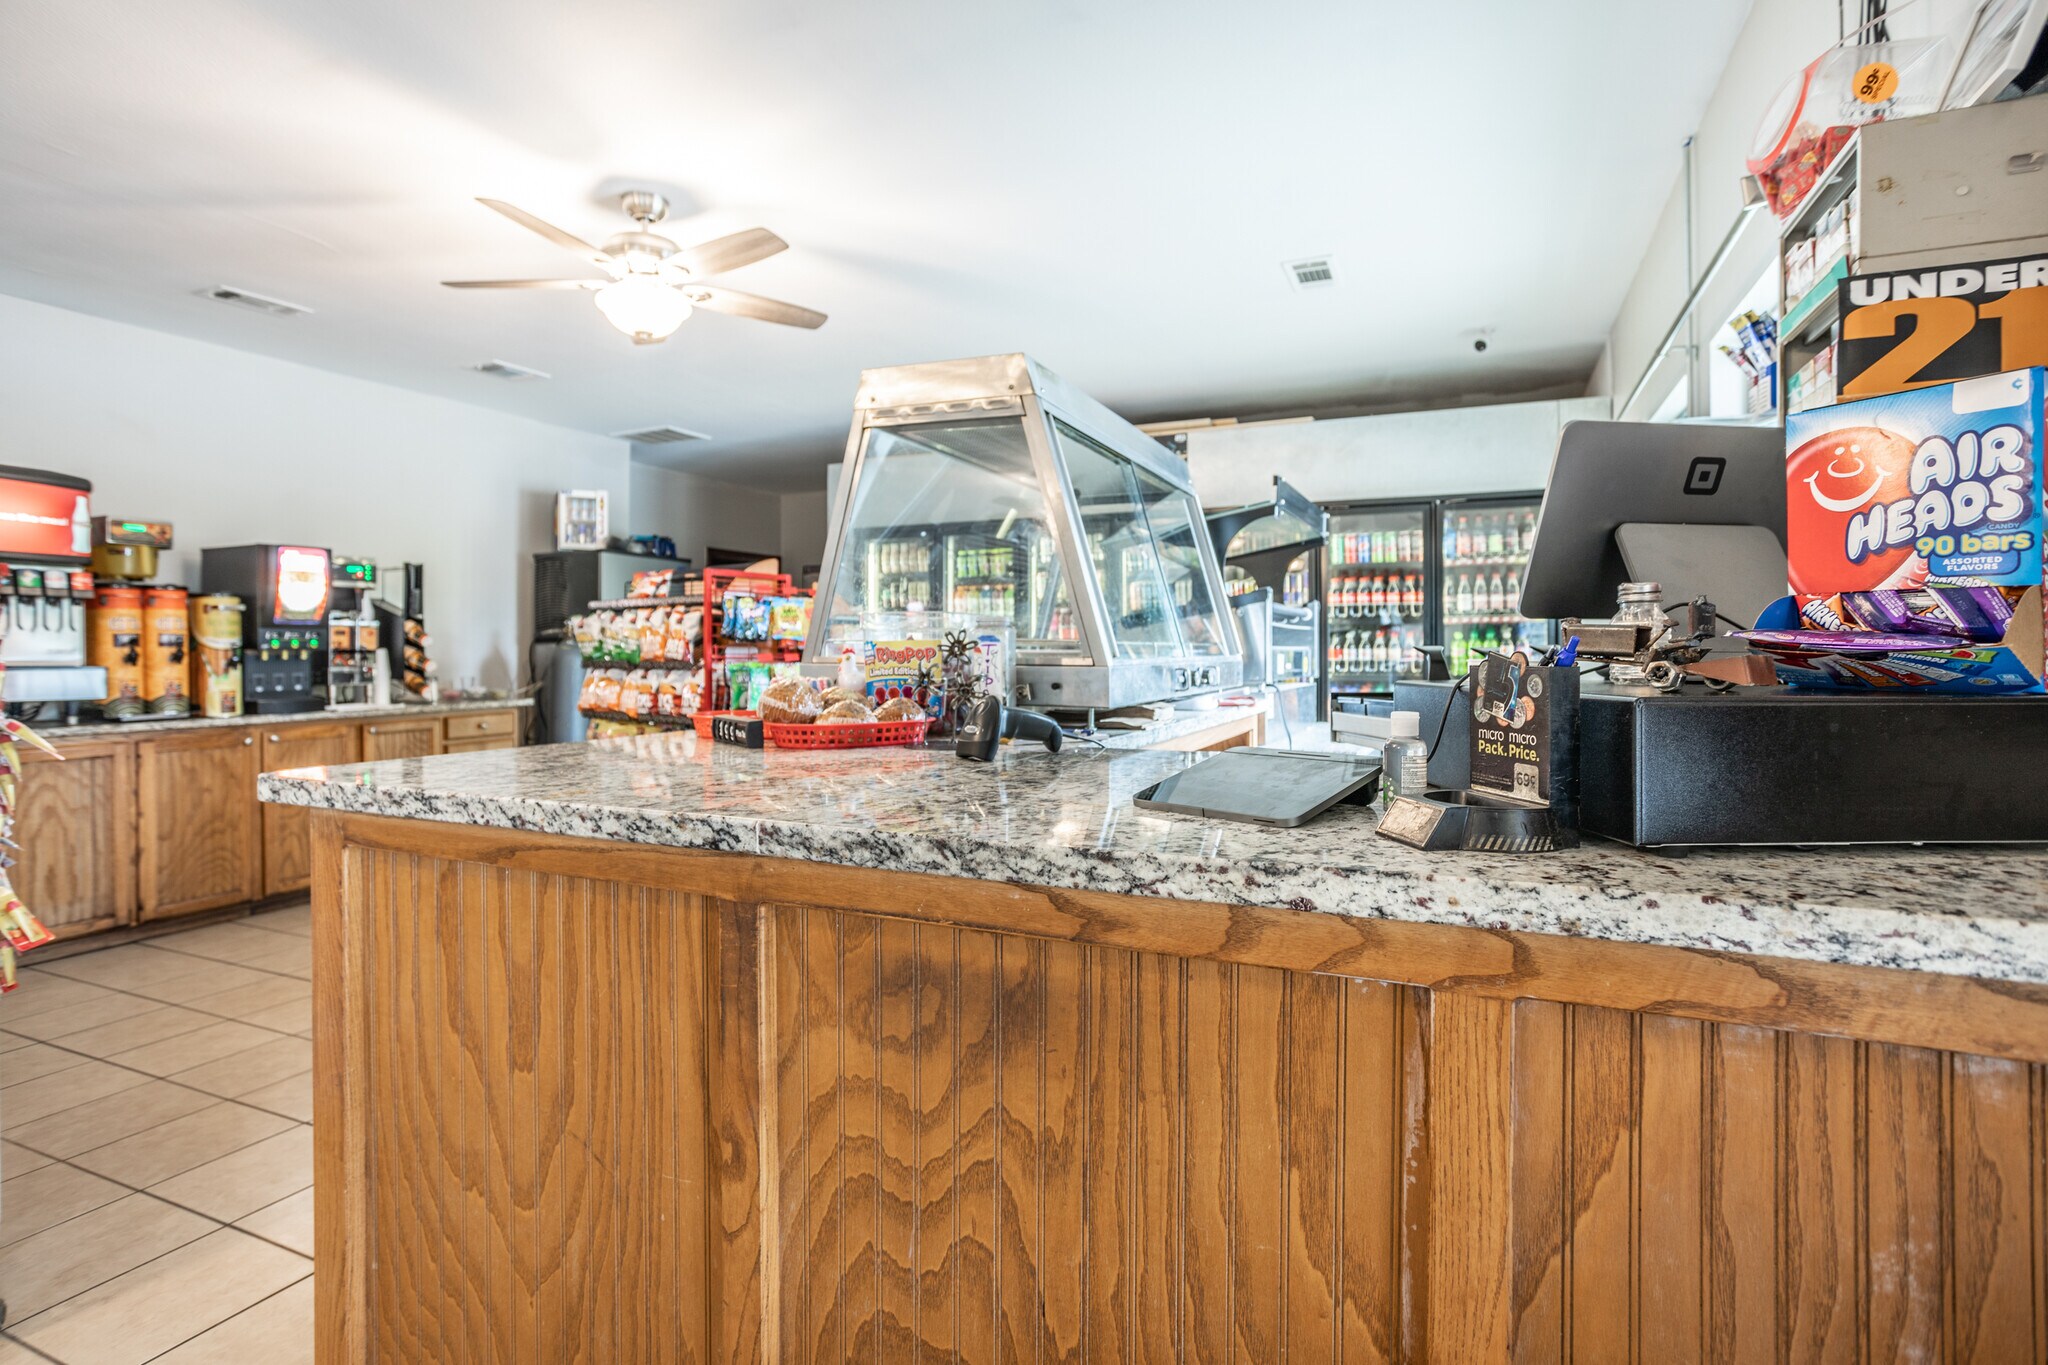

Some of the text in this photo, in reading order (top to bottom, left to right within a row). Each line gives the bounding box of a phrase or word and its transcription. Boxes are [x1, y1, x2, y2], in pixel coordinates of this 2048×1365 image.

[1850, 258, 2048, 306] UNDER
[1842, 286, 2048, 397] 21
[1910, 425, 2025, 495] AIR
[1847, 474, 2025, 560] HEADS
[1987, 522, 2020, 531] CANDY
[1915, 532, 2032, 555] 90 bars
[1942, 555, 2003, 566] ASSORTED
[1946, 563, 1998, 572] FLAVORS
[869, 665, 919, 678] Limited Edition
[1478, 728, 1537, 746] micro micro
[1478, 739, 1540, 762] Pack. Price.
[1516, 772, 1537, 787] 69¢
